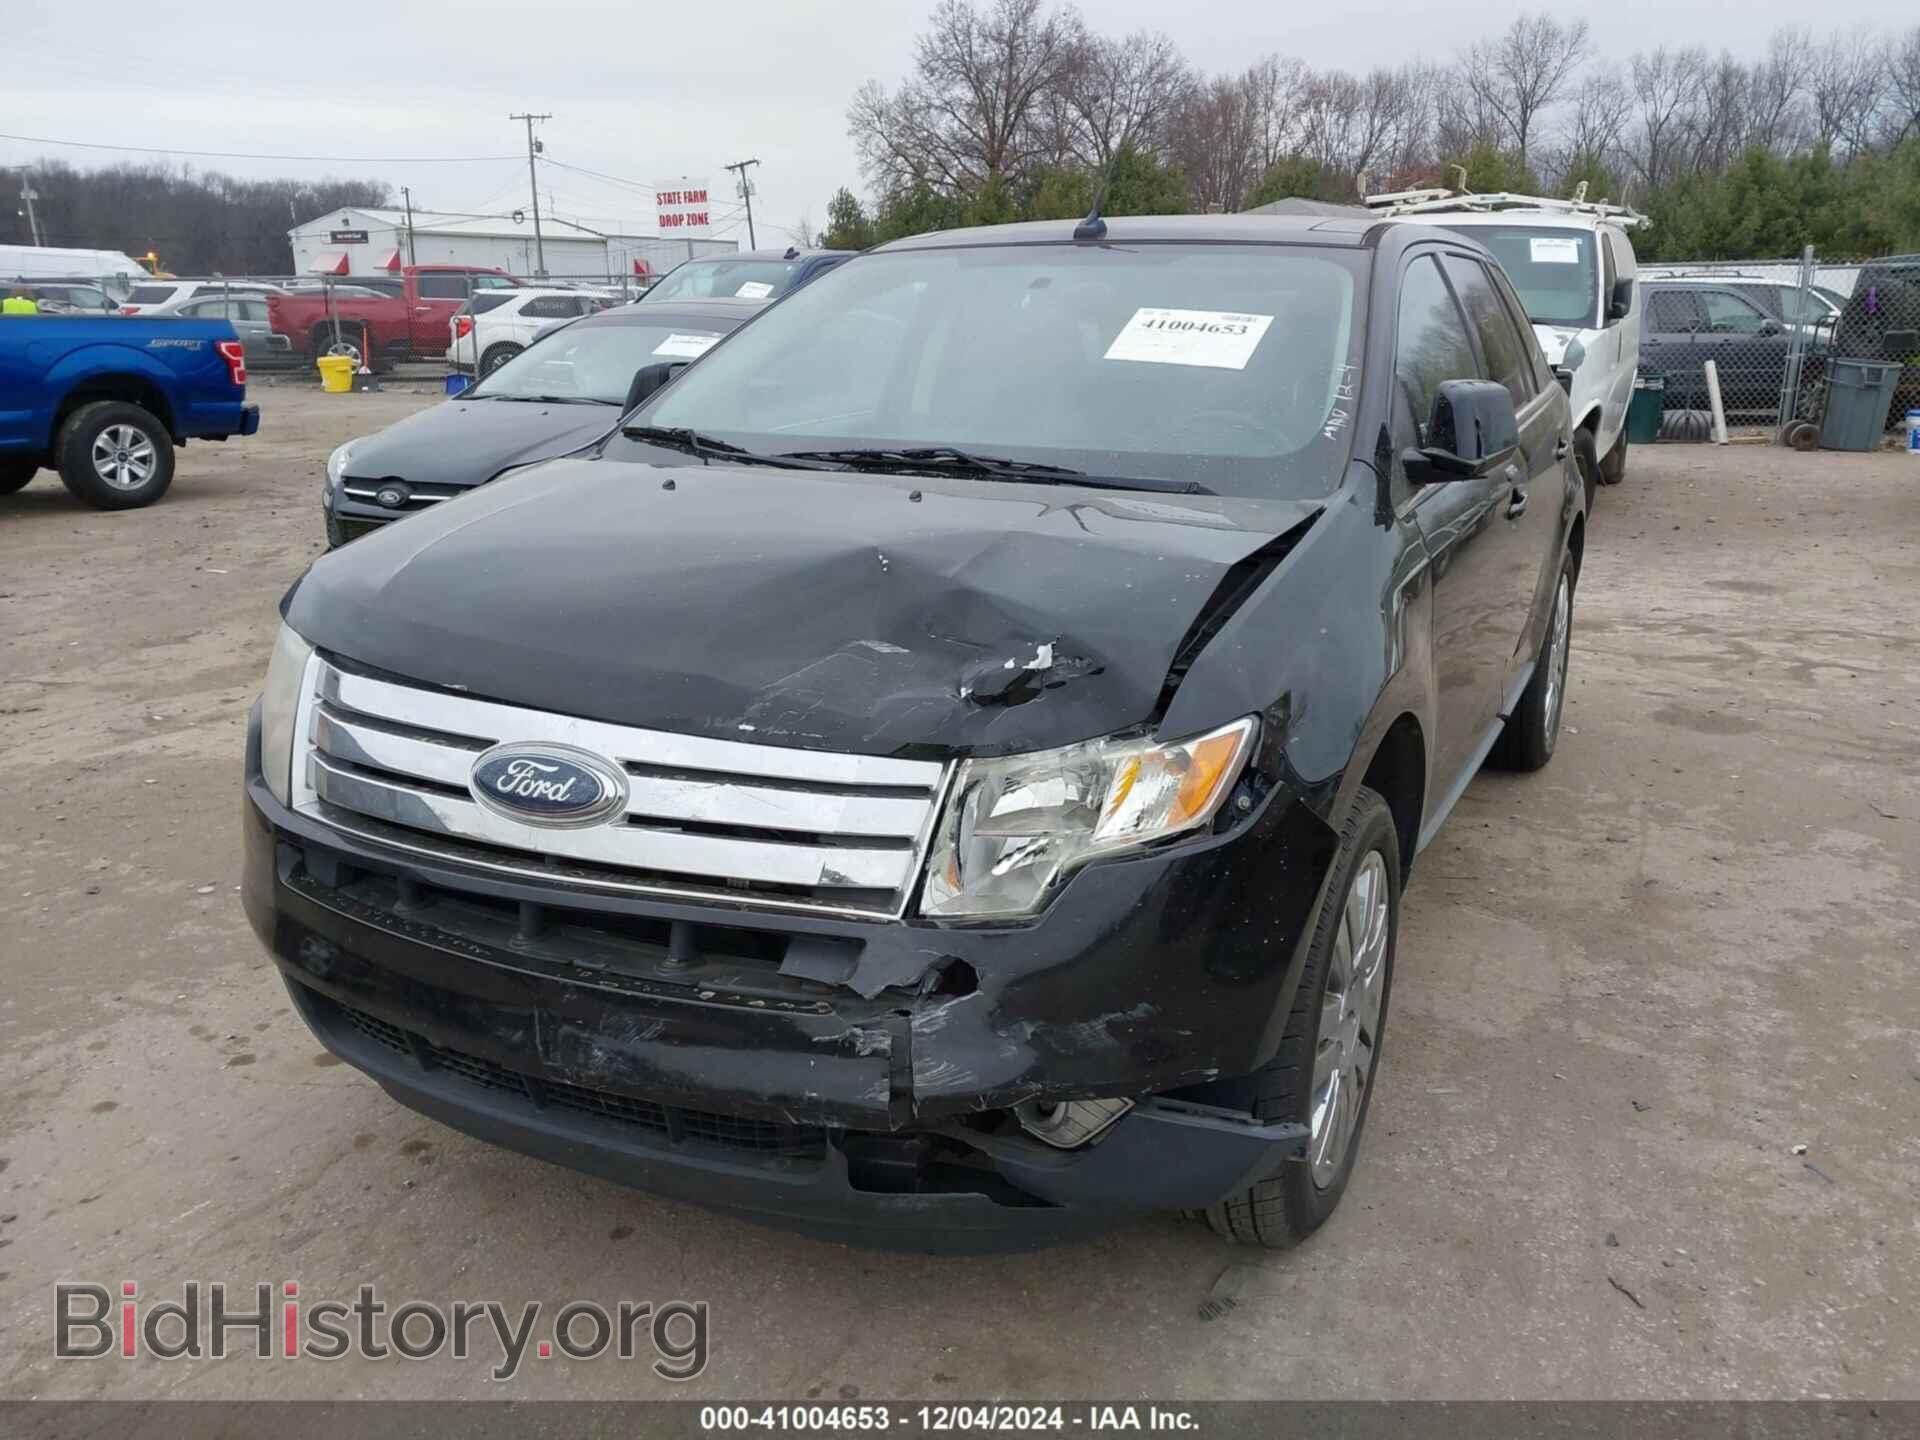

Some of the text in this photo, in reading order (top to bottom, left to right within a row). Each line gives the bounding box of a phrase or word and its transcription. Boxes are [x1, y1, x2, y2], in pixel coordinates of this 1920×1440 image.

[656, 190, 708, 205] STATE FARM
[659, 212, 710, 227] DROP ZONE
[1141, 319, 1249, 335] 41004653
[497, 759, 577, 801] Ford
